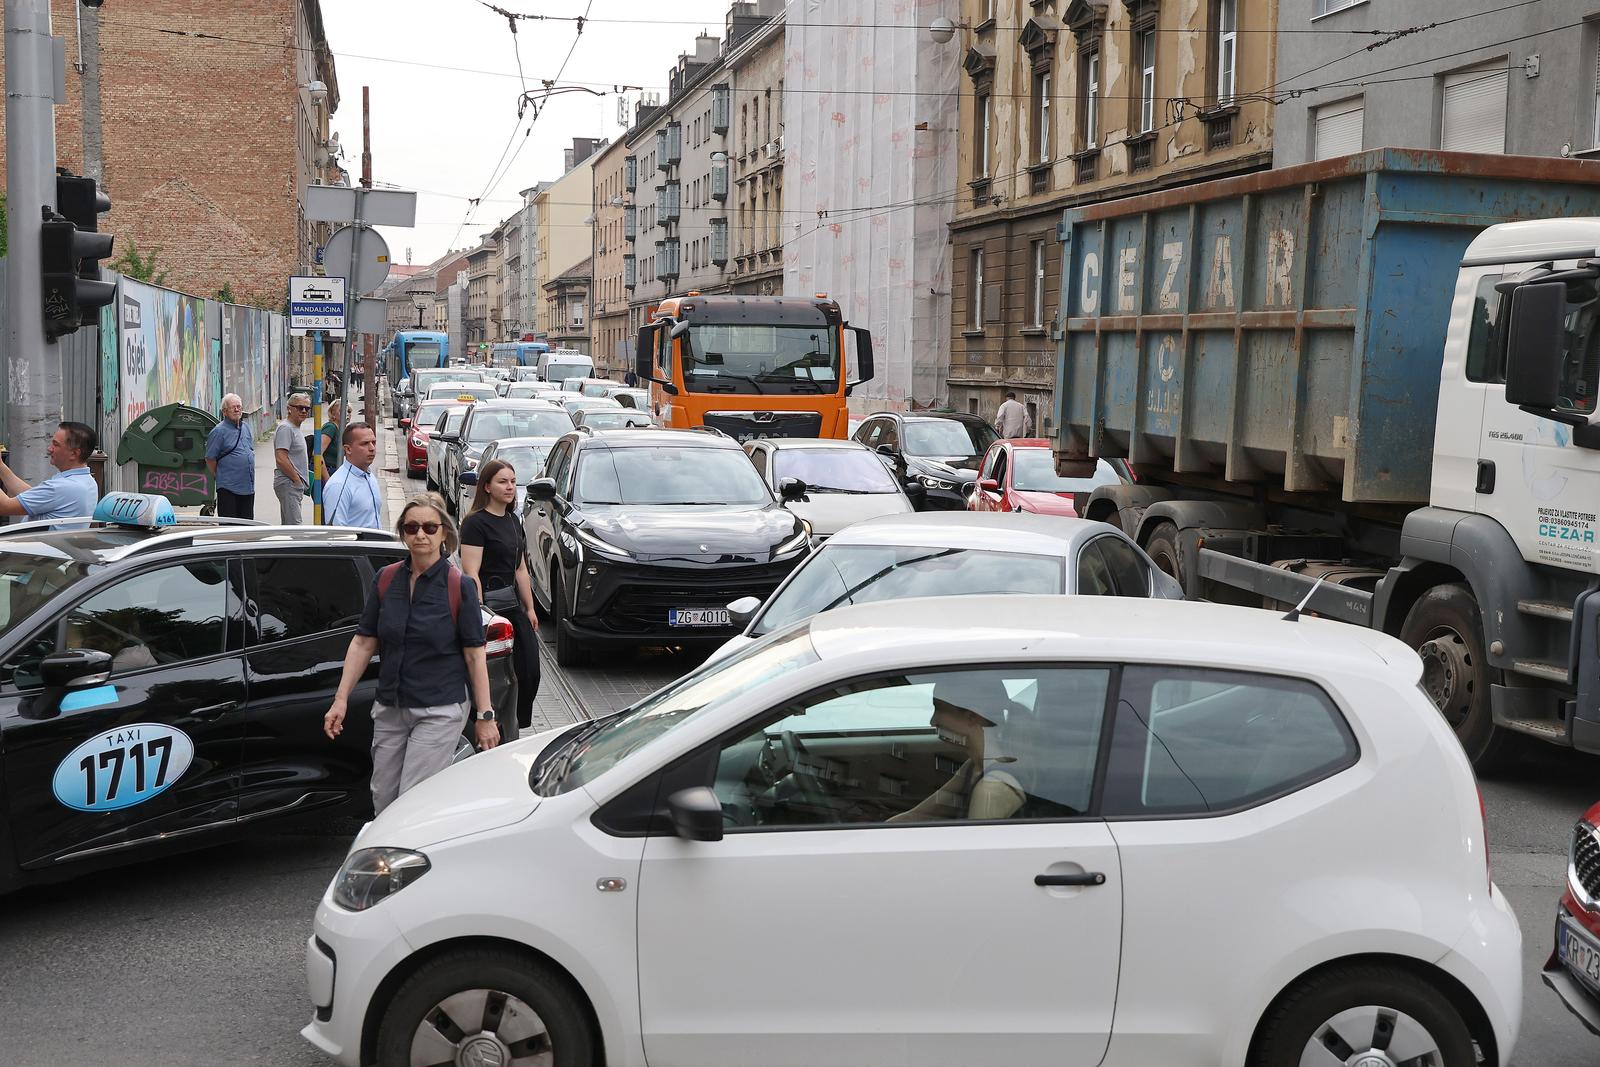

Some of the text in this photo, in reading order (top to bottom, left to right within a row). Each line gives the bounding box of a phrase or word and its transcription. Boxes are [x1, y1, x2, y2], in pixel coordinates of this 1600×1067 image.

[1080, 229, 1295, 313] CEZAR
[293, 305, 342, 313] MANDALIČINA
[295, 317, 313, 326] linije
[126, 332, 146, 384] Osjeti
[111, 497, 143, 518] 1717
[157, 515, 175, 523] 4161
[677, 611, 692, 624] ZG
[106, 729, 141, 747] TAXI
[80, 735, 173, 806] 1717
[1566, 933, 1579, 965] KR
